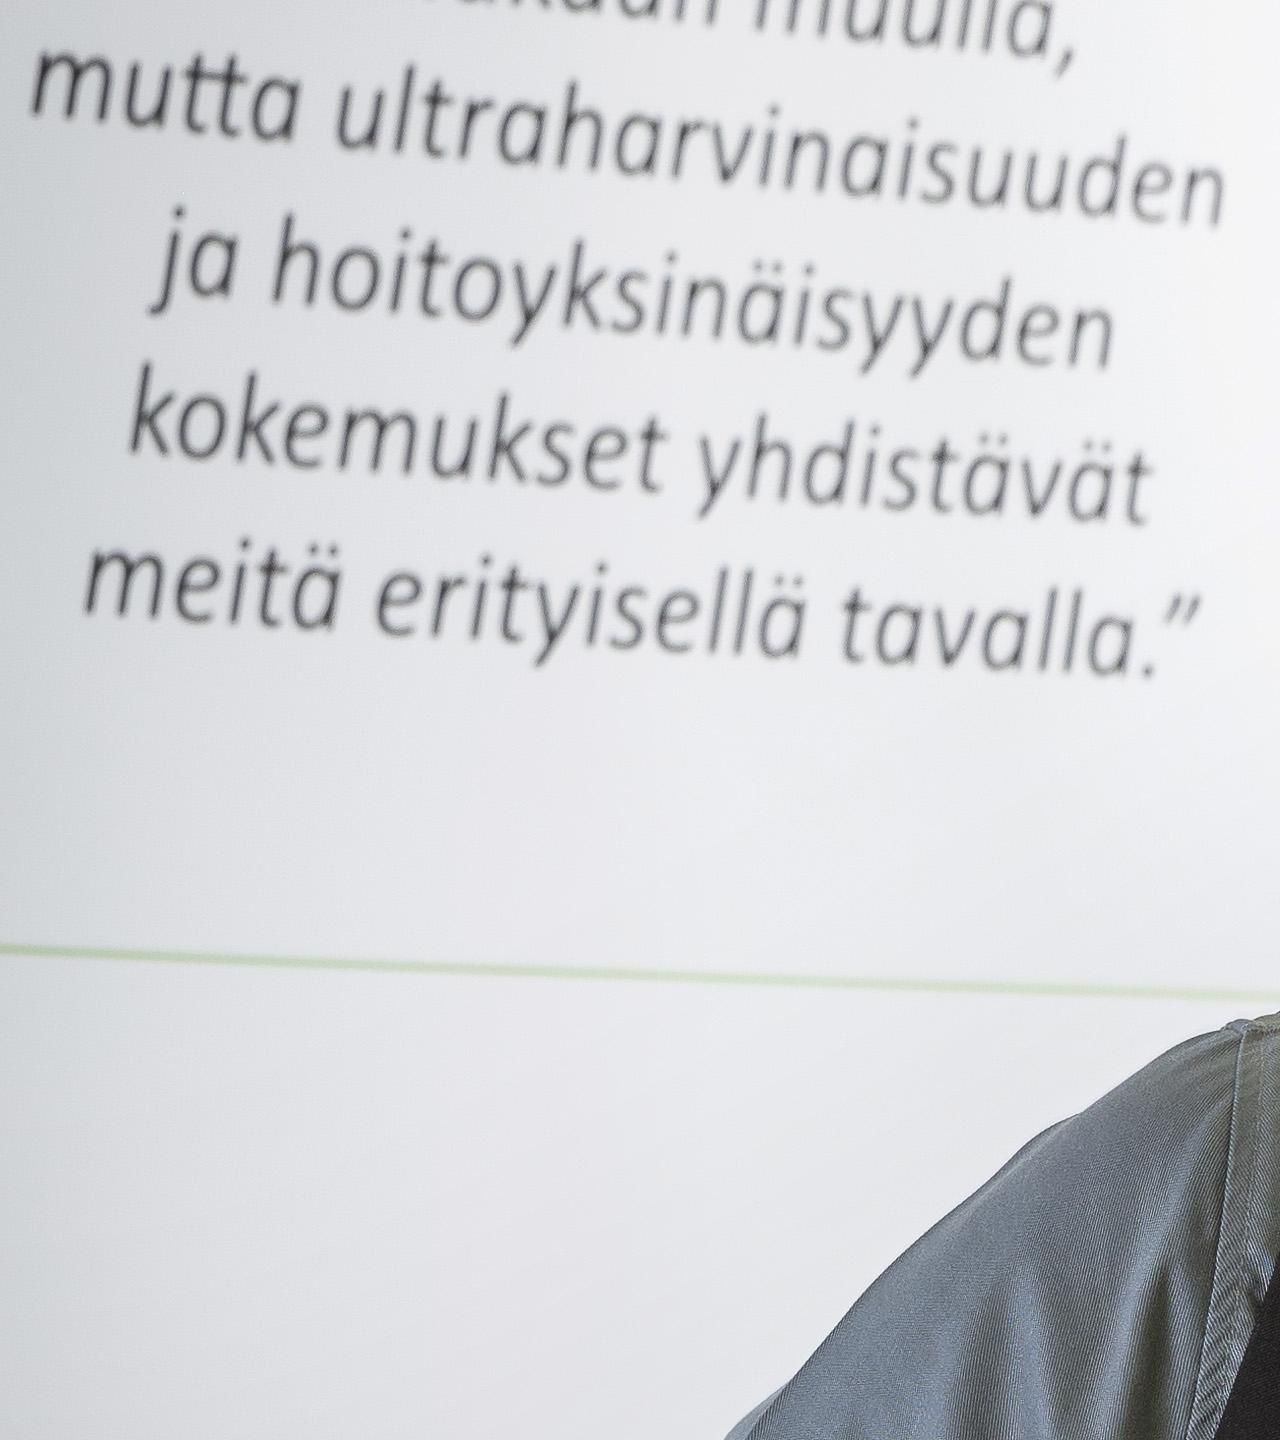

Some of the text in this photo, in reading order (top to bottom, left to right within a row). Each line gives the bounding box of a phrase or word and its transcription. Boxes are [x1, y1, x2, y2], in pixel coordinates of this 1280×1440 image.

[28, 49, 1226, 228] mutta ultraharvinaisuuden
[146, 203, 1114, 380] ja hoitoyksinäisyyden
[126, 358, 1153, 529] kokemukset yhdistävät
[81, 535, 344, 634] meitä
[373, 552, 808, 669] erityisellä
